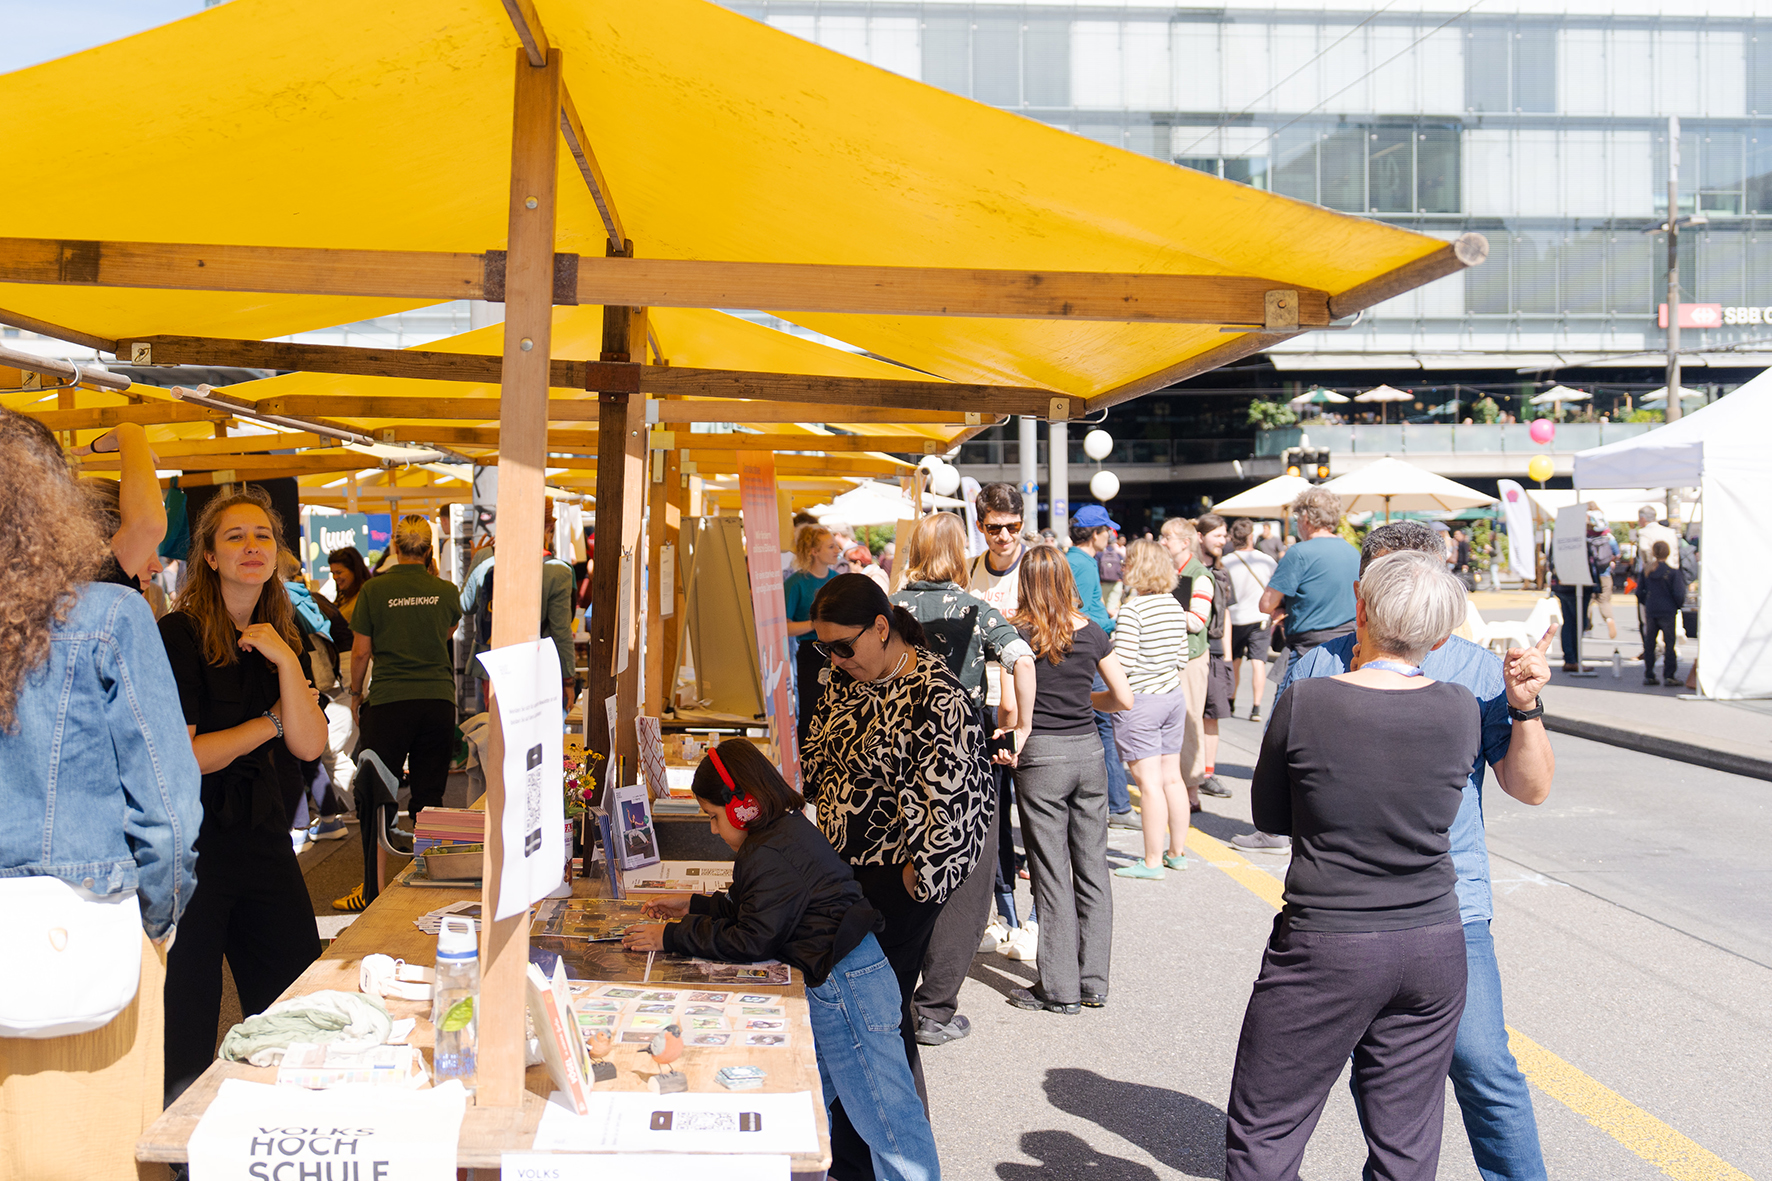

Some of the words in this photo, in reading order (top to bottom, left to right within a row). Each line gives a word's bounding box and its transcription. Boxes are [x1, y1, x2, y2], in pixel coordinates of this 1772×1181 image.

[1724, 306, 1761, 325] SBB
[388, 596, 439, 608] SCHWEIKHOF
[981, 590, 1005, 602] JUST
[258, 1127, 375, 1136] VOLKS
[250, 1137, 358, 1156] HOCH
[517, 1168, 560, 1179] VOLKS
